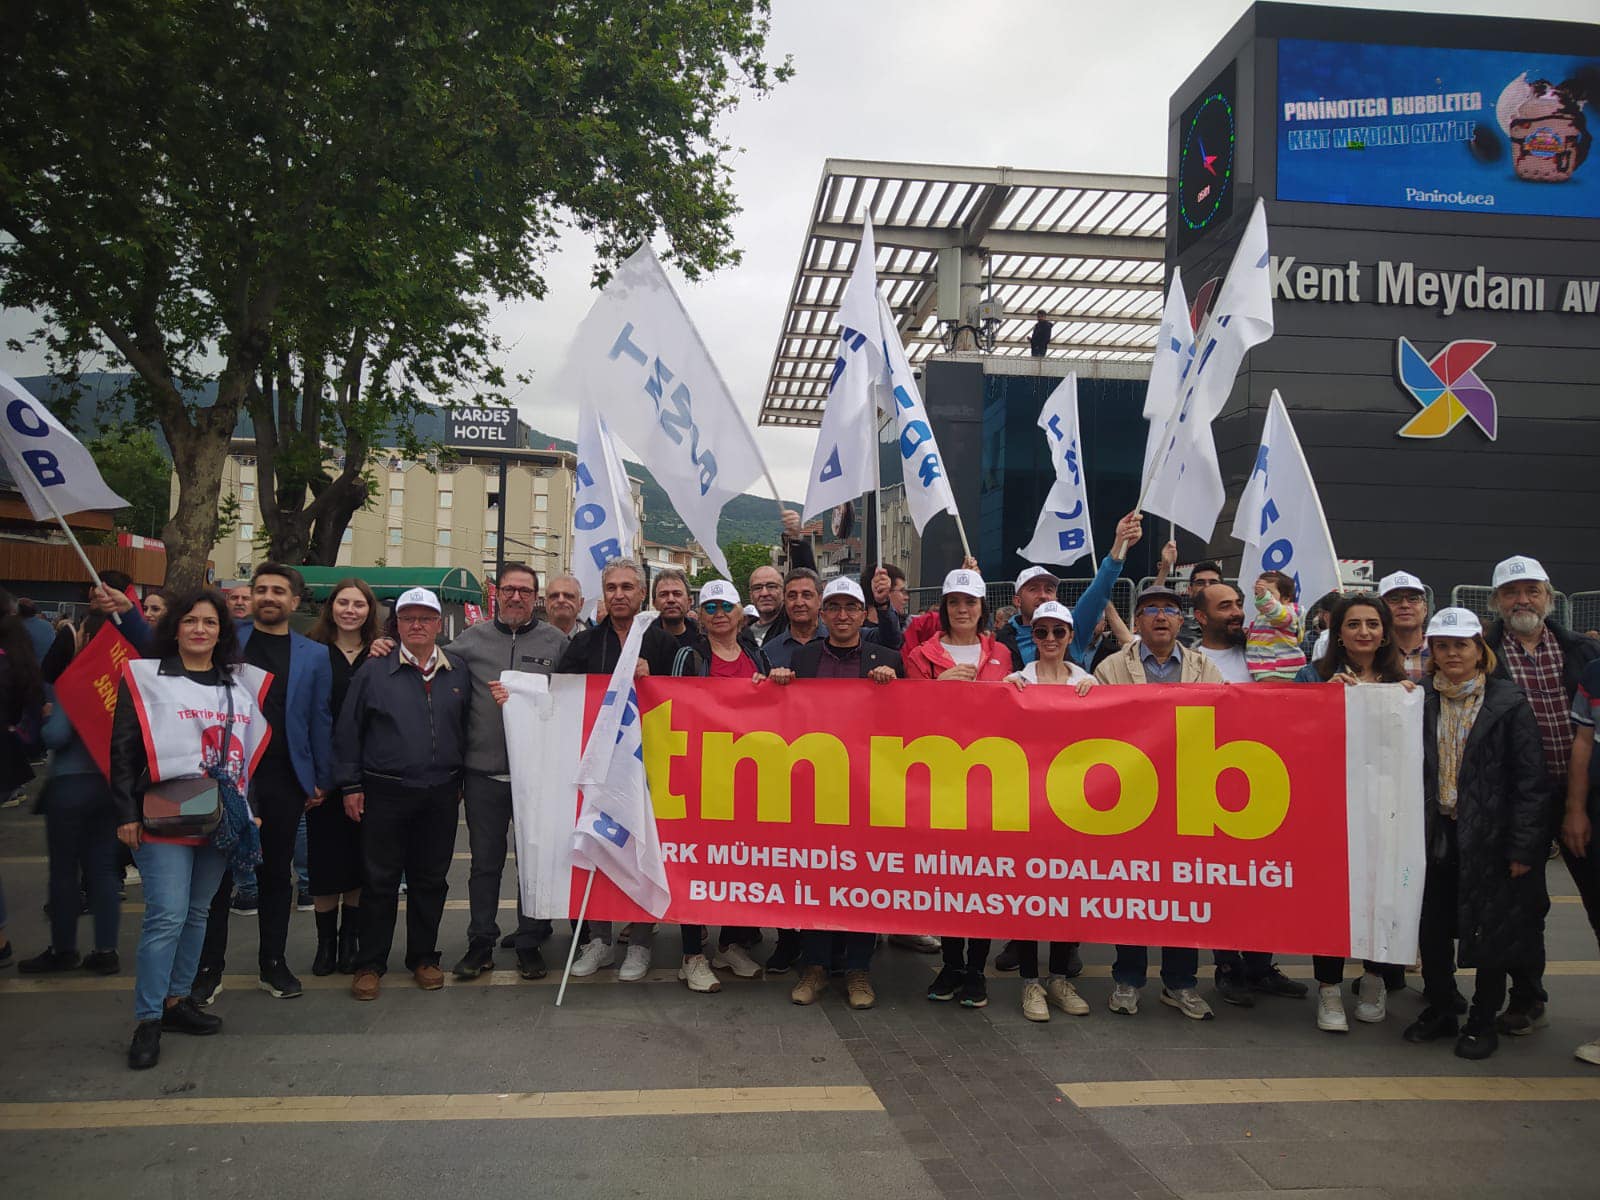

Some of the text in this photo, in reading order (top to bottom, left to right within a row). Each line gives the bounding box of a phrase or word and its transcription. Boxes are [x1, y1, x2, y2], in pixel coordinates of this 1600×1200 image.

[1391, 91, 1482, 116] BUBBLETEA
[1288, 129, 1331, 151] KENT
[1332, 124, 1410, 149] MEYDANI
[1406, 187, 1495, 206] Paninoteca
[1269, 255, 1361, 303] Kent
[1378, 261, 1545, 316] Meydanı
[451, 408, 511, 426] KARDEŞ
[454, 425, 507, 440] HOTEL
[641, 699, 1291, 840] tmmob
[707, 841, 857, 871] MÜHENDİS
[866, 852, 904, 874] VE
[915, 849, 1016, 878] MİMAR
[1025, 857, 1161, 883] ODALARI
[1172, 857, 1294, 888] BİRLİĞİ
[689, 879, 1212, 923] BURSA İL KOORDİNASYON KURULU
